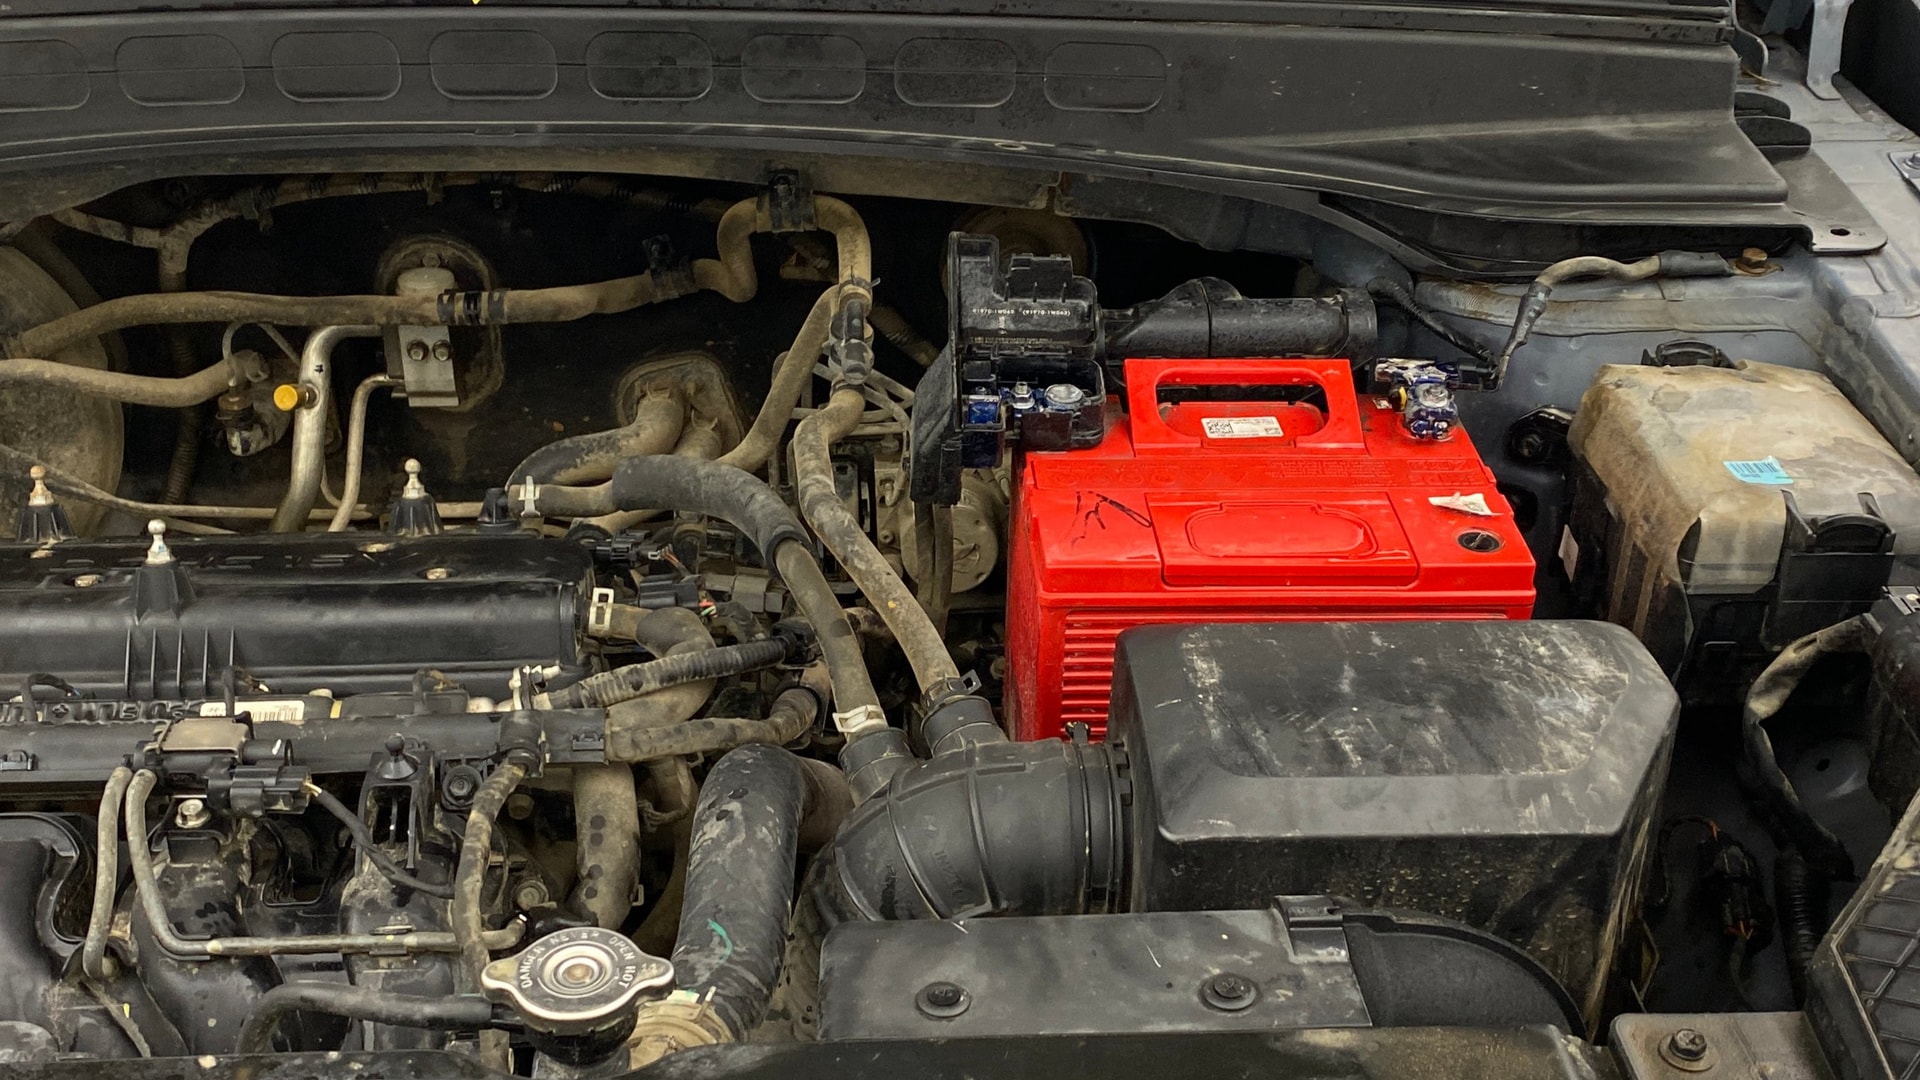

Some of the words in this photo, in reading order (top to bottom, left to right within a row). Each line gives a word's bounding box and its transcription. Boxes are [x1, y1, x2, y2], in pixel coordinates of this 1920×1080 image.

[549, 930, 600, 946] NEVER
[608, 936, 635, 961] OPEN
[518, 946, 546, 989] DANGER
[618, 964, 637, 989] HOT
